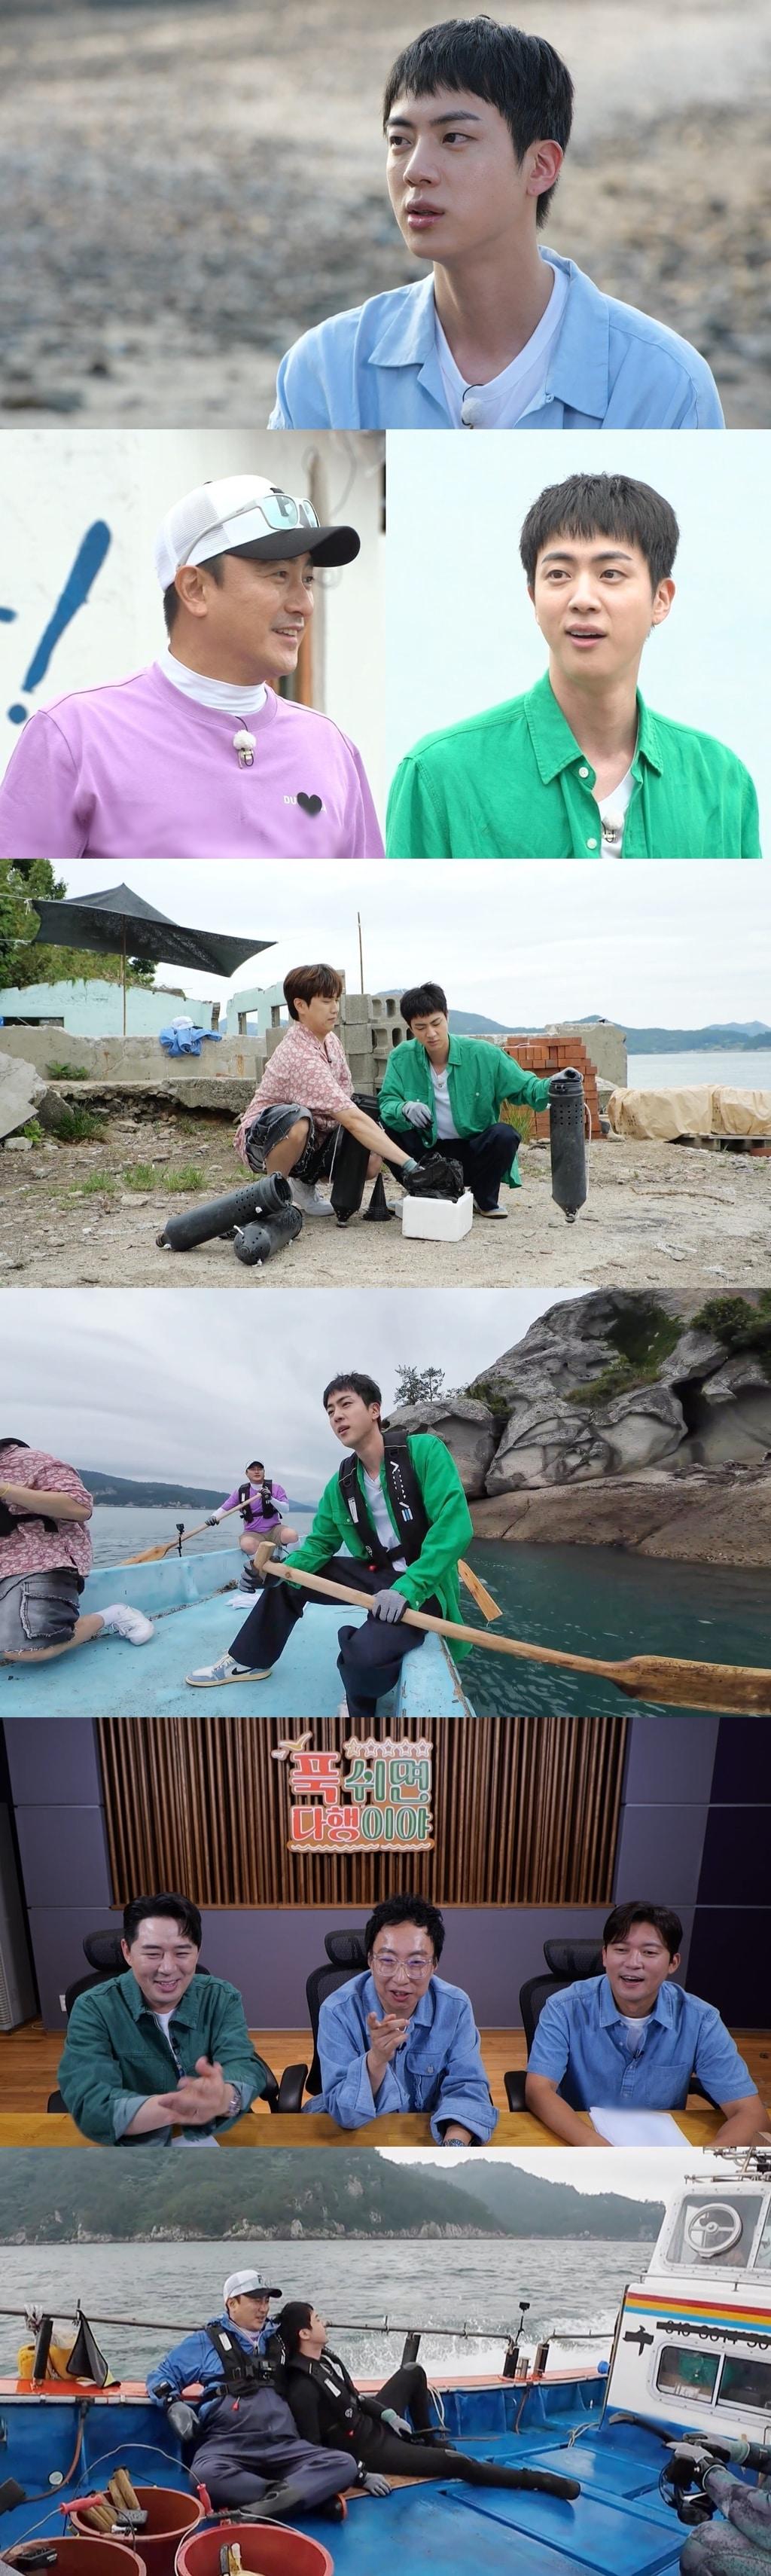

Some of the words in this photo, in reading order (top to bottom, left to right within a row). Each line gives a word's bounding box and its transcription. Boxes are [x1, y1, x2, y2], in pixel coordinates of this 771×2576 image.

[291, 1752, 340, 1805] 푹
[344, 1759, 431, 1804] 쉬면
[291, 1805, 431, 1842] 다행이야
